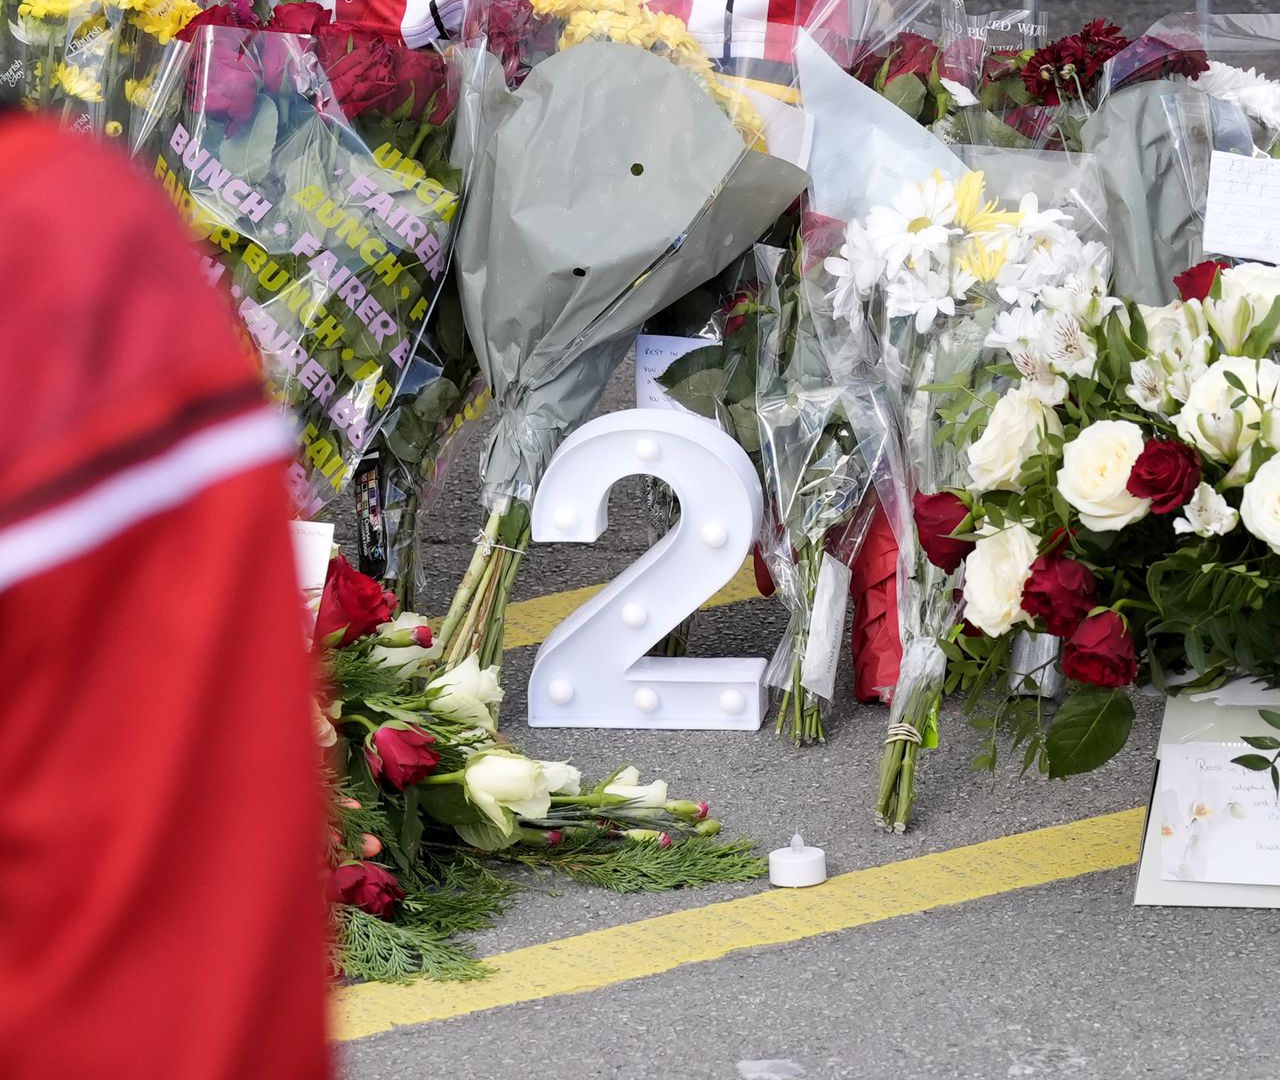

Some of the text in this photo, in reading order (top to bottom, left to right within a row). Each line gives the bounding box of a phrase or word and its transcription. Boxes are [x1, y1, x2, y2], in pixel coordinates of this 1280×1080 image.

[68, 24, 104, 52] Flourish
[170, 122, 273, 223] BUNCH
[292, 184, 404, 288] BUNCH
[347, 174, 448, 282] FAIRER
[241, 242, 347, 349] BUNCH
[290, 231, 398, 351] FAIRER
[528, 408, 768, 731] 2
